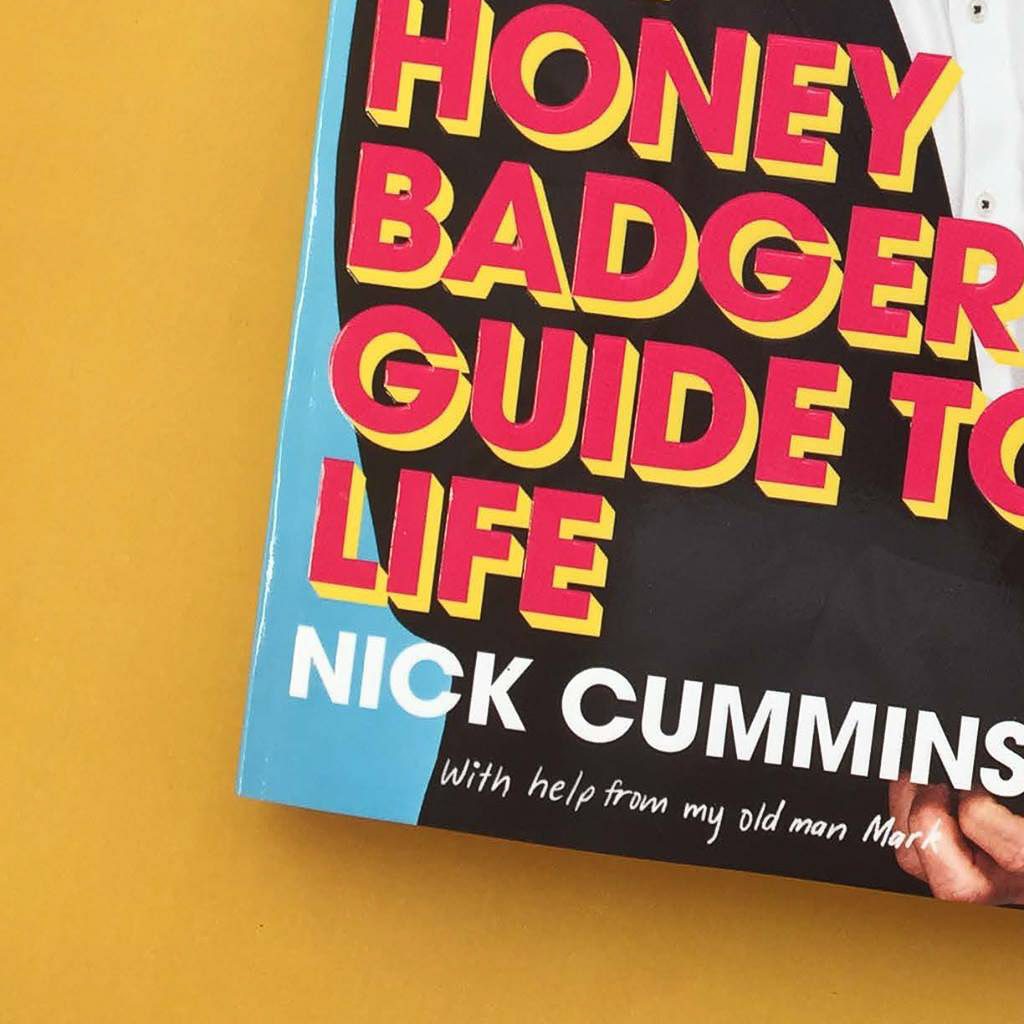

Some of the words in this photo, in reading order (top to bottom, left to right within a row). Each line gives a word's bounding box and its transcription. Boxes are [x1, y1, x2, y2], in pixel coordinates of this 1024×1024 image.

[329, 304, 852, 506] GUIDE
[308, 457, 615, 636] LIFE
[288, 625, 533, 731] NICK
[440, 759, 511, 798] With
[527, 765, 595, 811] help
[603, 780, 667, 814] from
[683, 802, 726, 845] my
[739, 799, 787, 833] old
[789, 817, 846, 841] man
[862, 814, 944, 852] Mark
